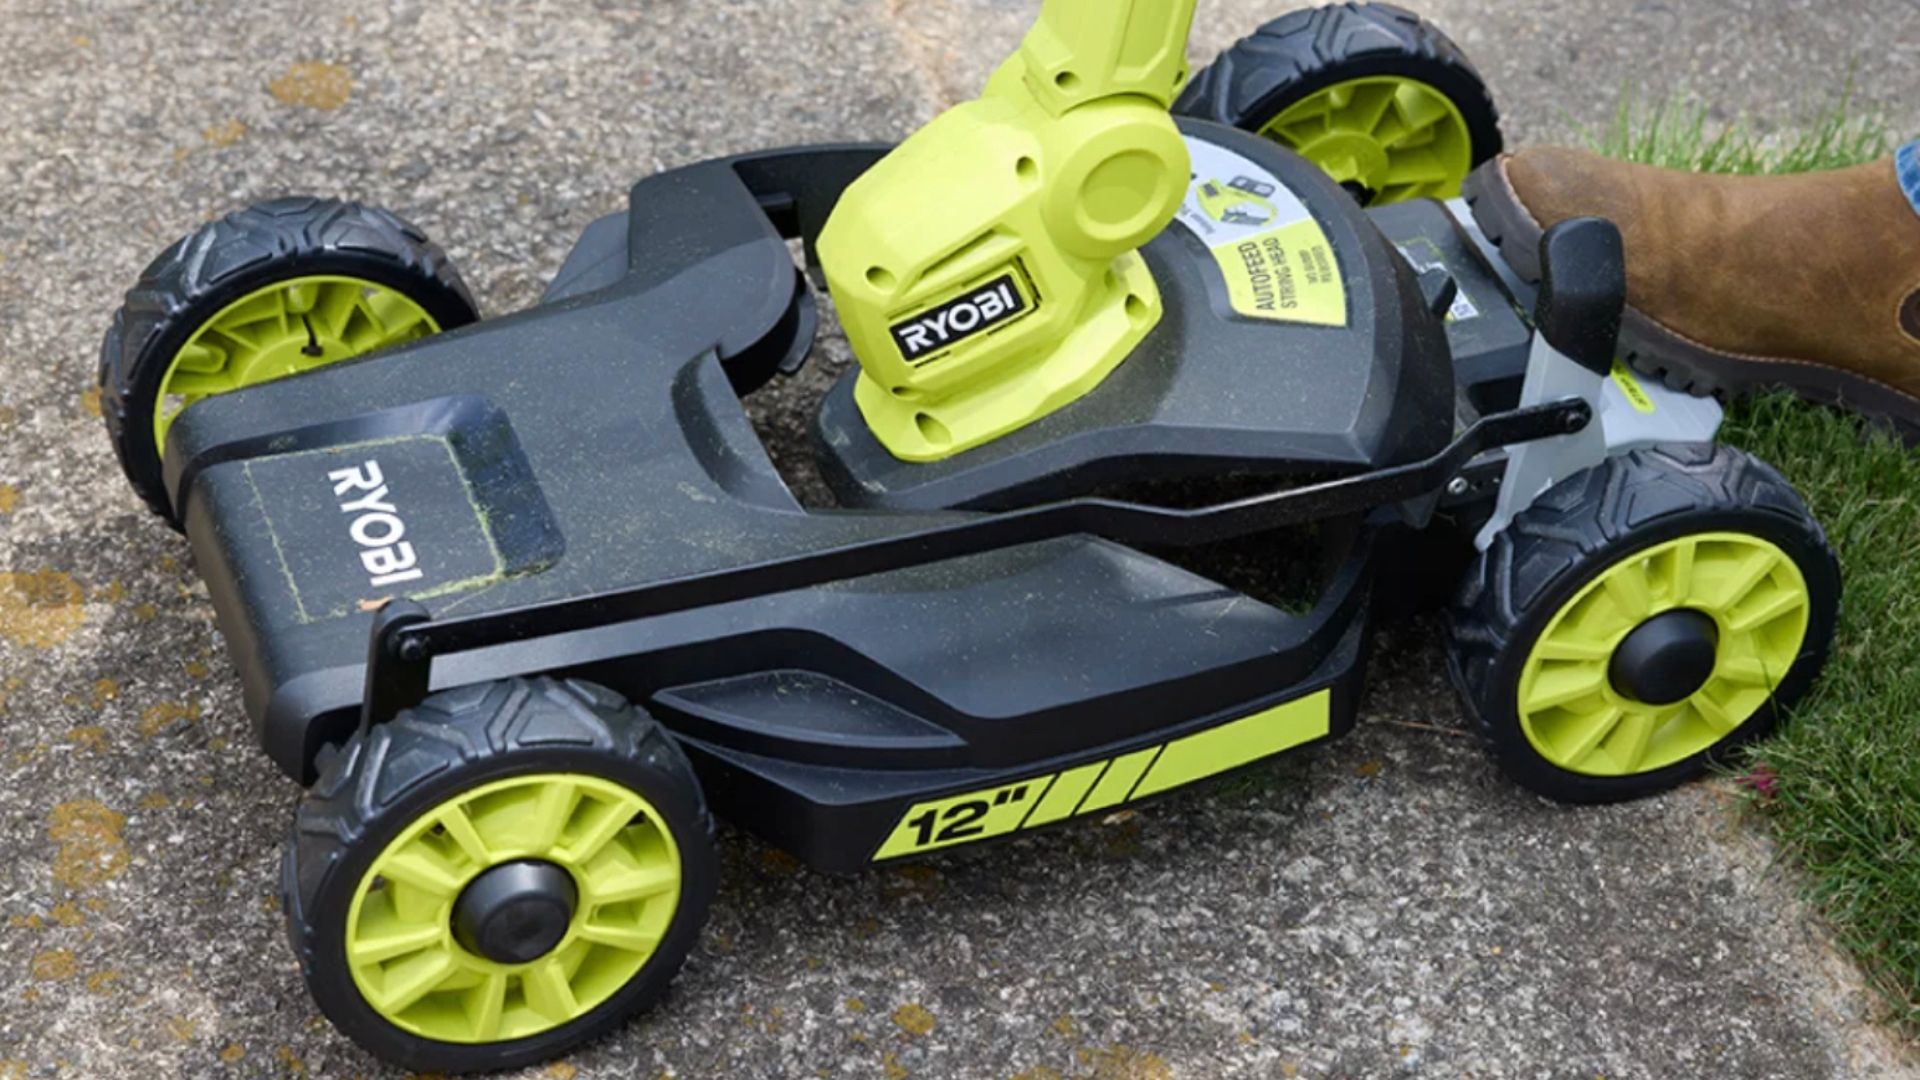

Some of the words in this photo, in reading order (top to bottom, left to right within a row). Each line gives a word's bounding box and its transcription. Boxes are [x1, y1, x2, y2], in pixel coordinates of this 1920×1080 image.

[1238, 242, 1275, 311] AUTOFEED
[1262, 237, 1286, 265] HEAD
[898, 283, 1015, 353] RYOBI
[1274, 266, 1298, 309] STRING
[327, 459, 424, 587] RYOBI
[908, 785, 1029, 847] 12"
